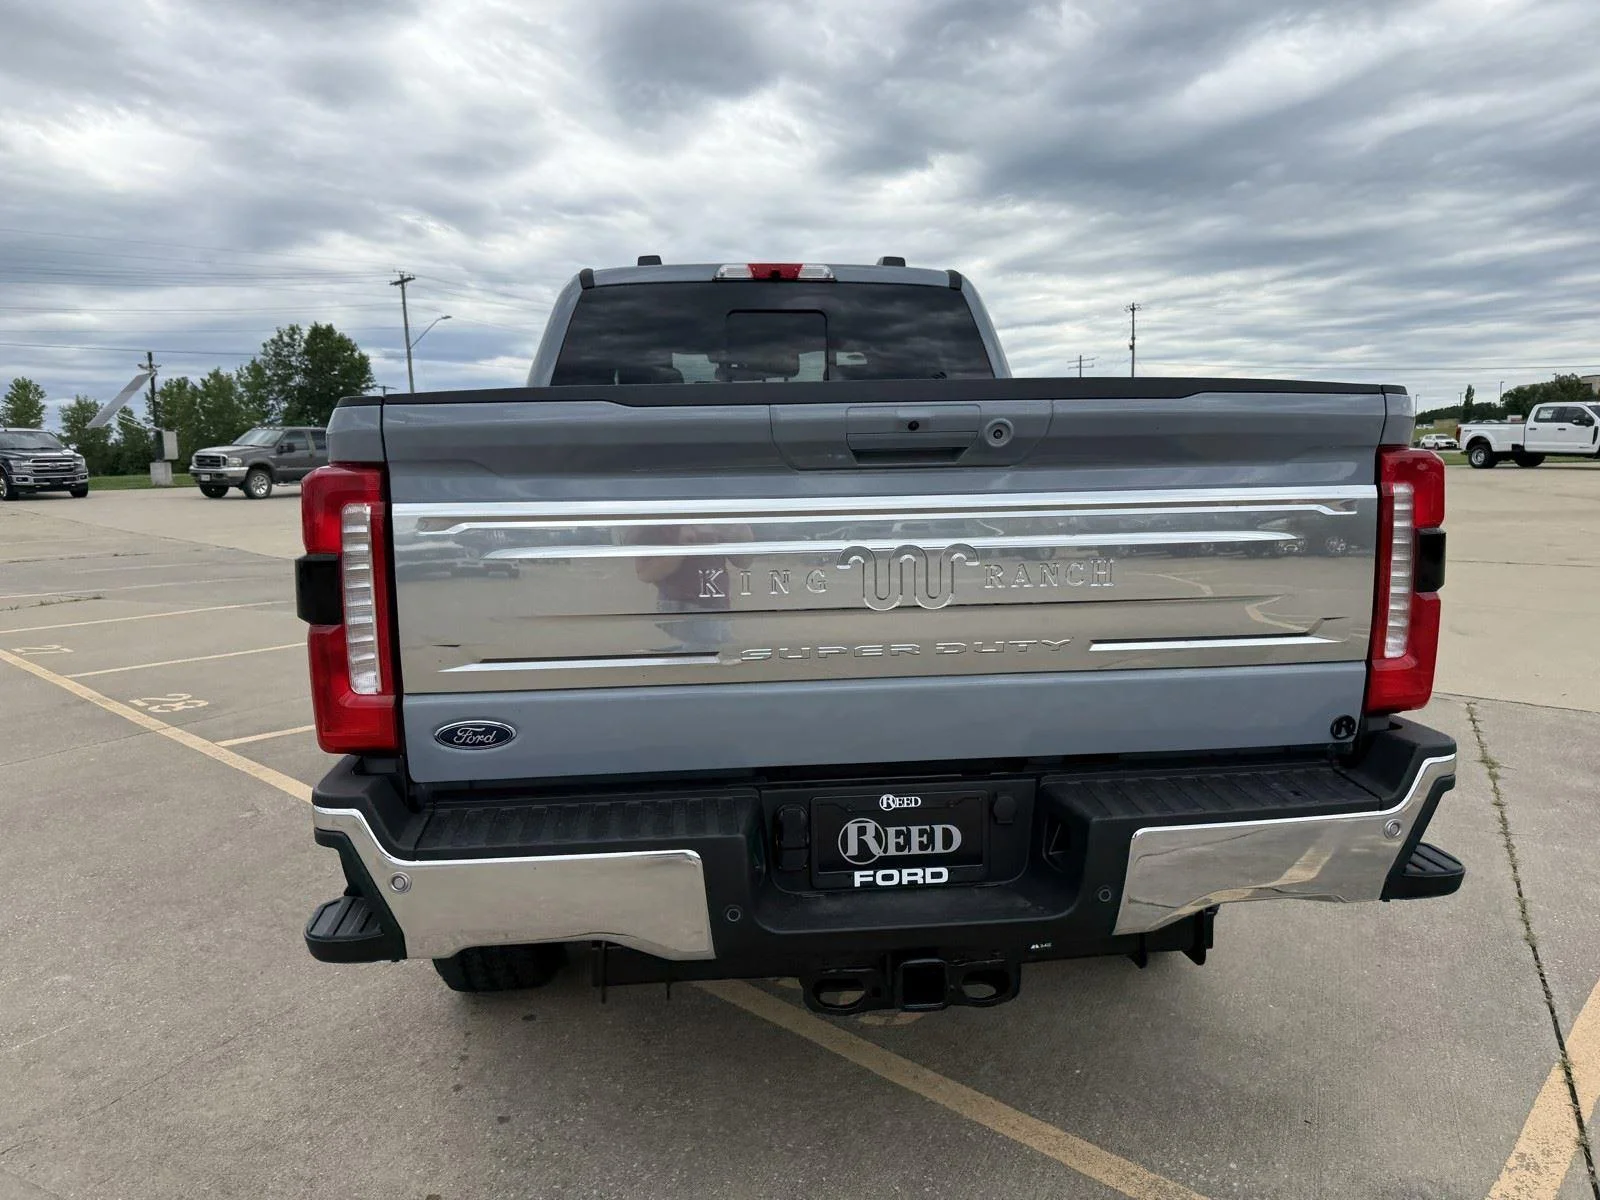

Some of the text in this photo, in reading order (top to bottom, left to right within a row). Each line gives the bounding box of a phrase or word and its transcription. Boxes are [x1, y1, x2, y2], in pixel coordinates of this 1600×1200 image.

[698, 558, 1115, 598] KING RANCH
[740, 638, 1074, 662] SUPER DUTY
[453, 727, 497, 744] Ford
[880, 794, 922, 810] REED
[844, 820, 963, 860] REED
[854, 867, 949, 888] FORD
